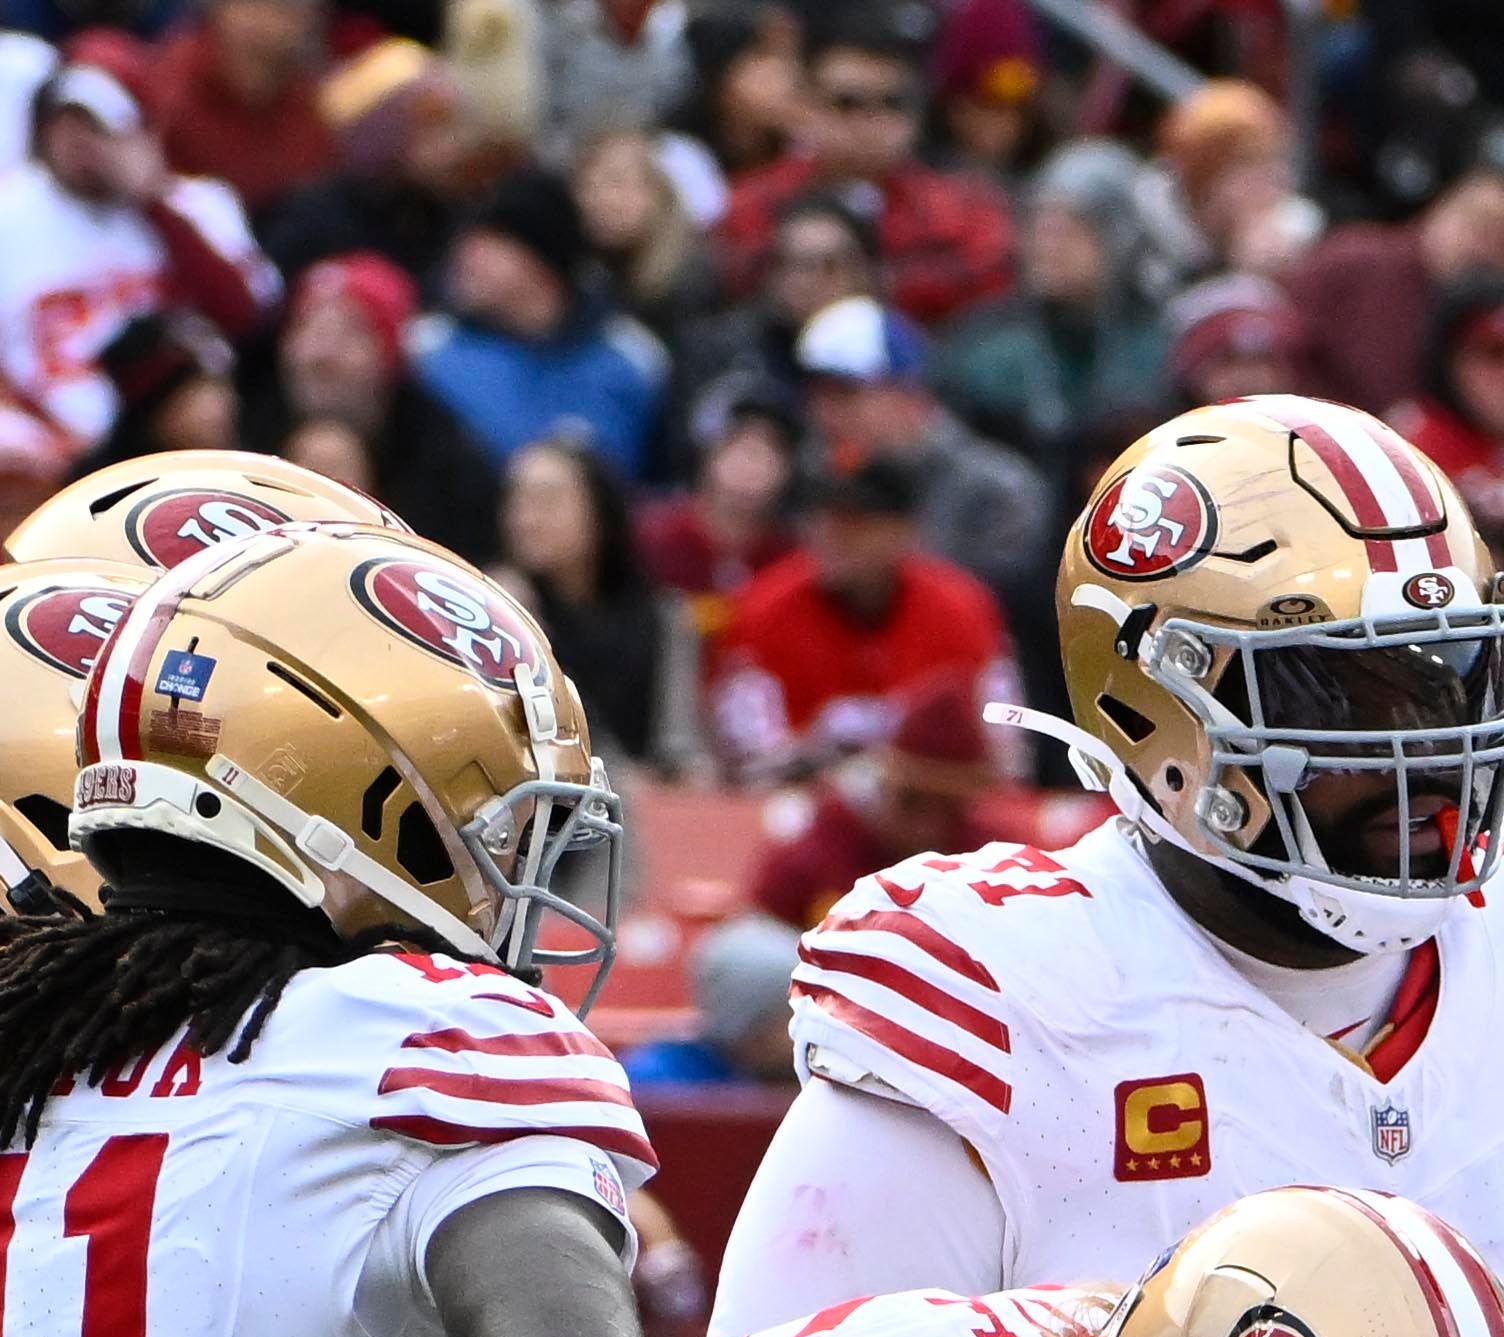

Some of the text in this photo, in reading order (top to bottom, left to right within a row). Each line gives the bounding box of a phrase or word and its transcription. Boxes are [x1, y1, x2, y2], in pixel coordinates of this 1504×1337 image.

[1106, 473, 1185, 567] SF
[1124, 1082, 1203, 1155] C
[1380, 1128, 1408, 1152] NFL
